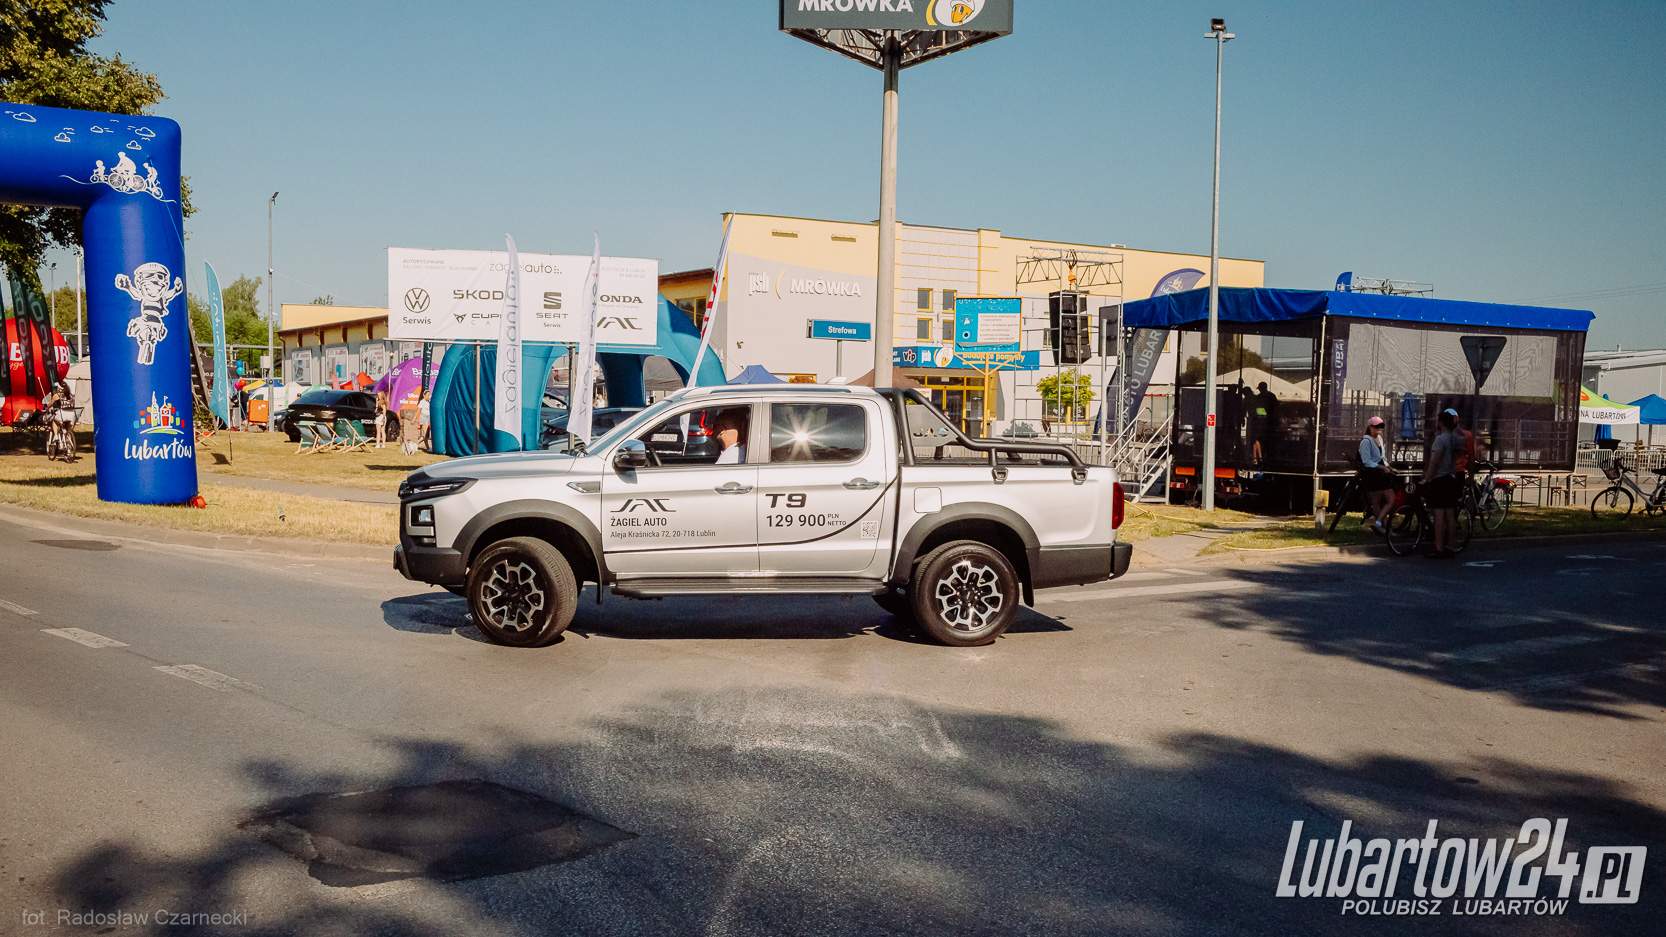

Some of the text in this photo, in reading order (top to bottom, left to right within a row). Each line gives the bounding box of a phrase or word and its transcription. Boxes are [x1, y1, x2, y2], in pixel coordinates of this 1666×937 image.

[453, 289, 504, 300] SKOD
[600, 294, 643, 304] ONDA
[402, 316, 432, 325] Serwis
[1134, 330, 1162, 376] LUBAR
[124, 437, 192, 461] Lubartów
[765, 493, 807, 508] T9
[610, 516, 667, 527] ŻAGIEL AUTO
[766, 513, 826, 527] 129 900
[610, 530, 627, 539] Aleja
[628, 529, 660, 538] Kraśnicka
[672, 529, 695, 538] 20-718
[696, 529, 716, 538] Lublin
